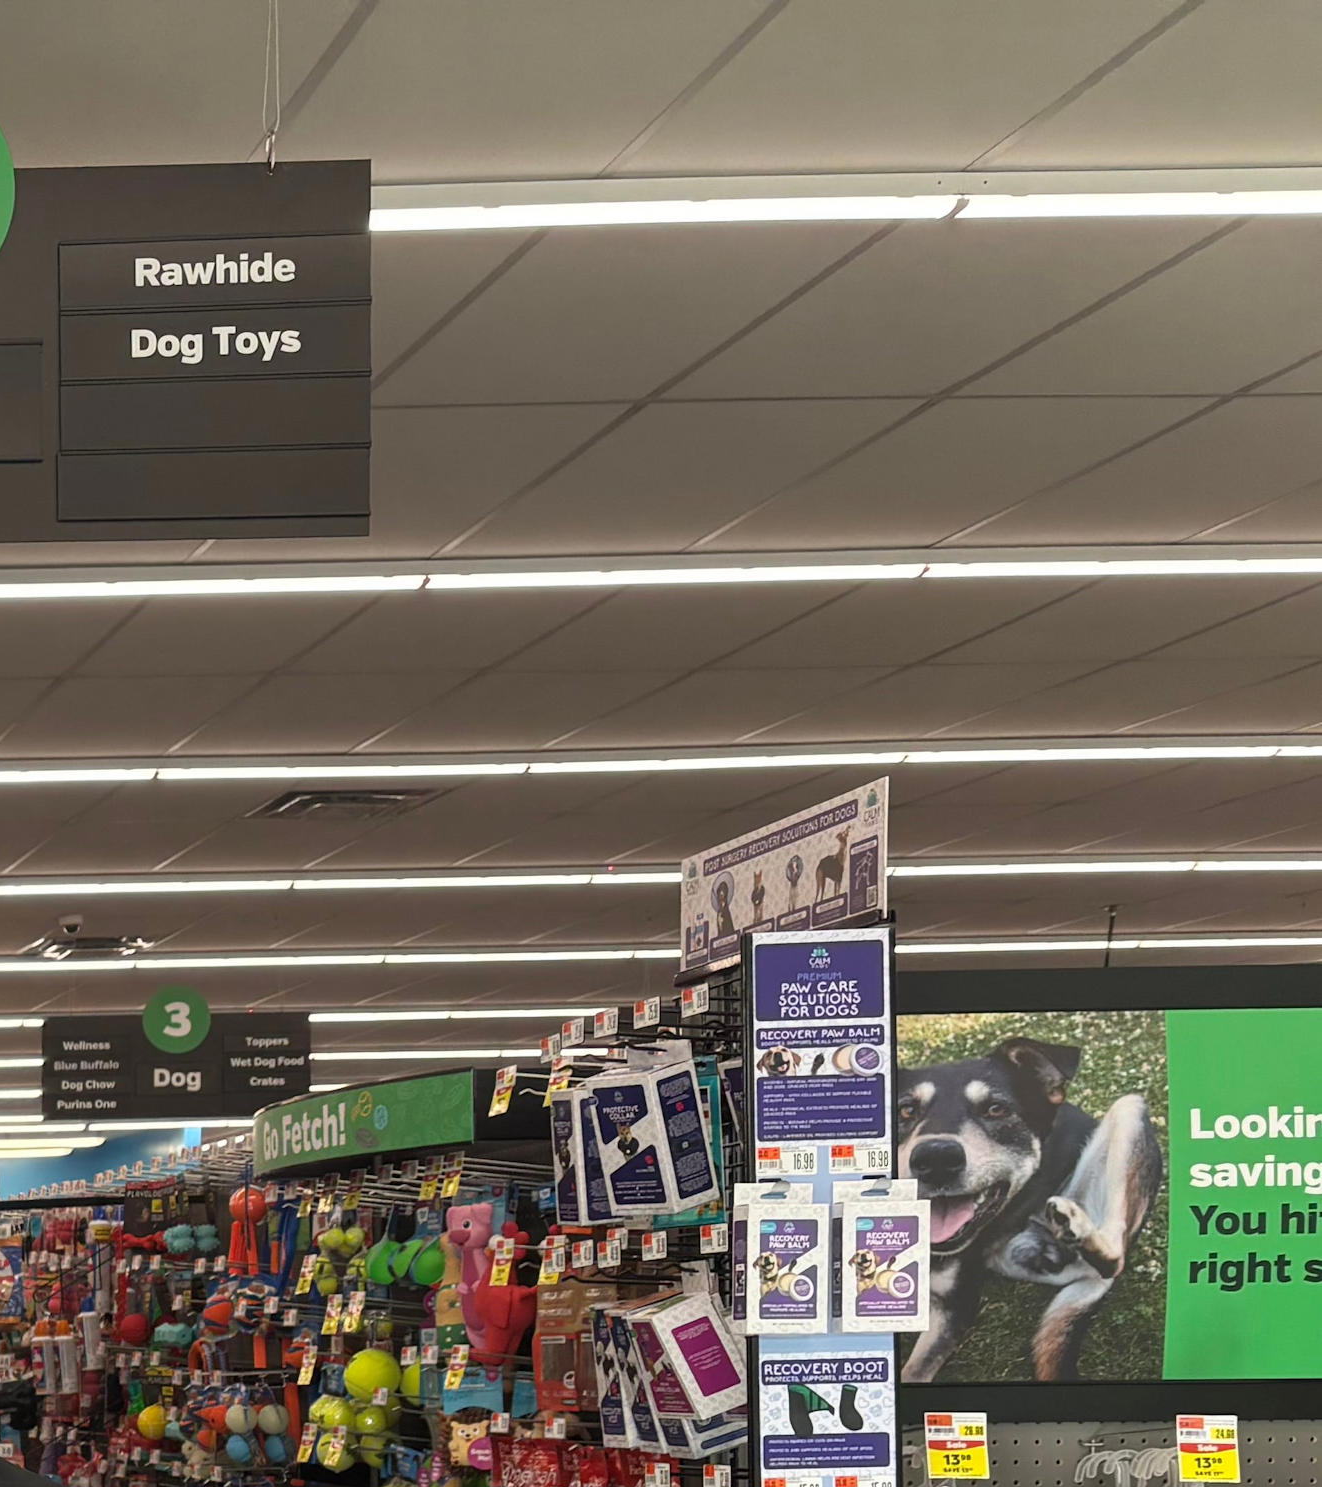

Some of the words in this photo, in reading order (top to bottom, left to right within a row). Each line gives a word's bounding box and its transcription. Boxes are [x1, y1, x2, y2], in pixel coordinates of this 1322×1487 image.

[134, 253, 296, 288] Rawhide
[130, 328, 203, 366] Dog
[211, 326, 302, 360] Toys
[781, 982, 811, 993] PAW
[817, 981, 857, 993] CARE
[779, 993, 861, 1006] SOLUTIONS
[781, 1006, 809, 1017] FOR
[814, 1004, 859, 1017] DOGS
[163, 1002, 192, 1037] 3
[760, 1030, 819, 1040] RECOVERY
[822, 1029, 845, 1038] PAW
[849, 1028, 880, 1037] BALM
[63, 1041, 110, 1051] Wellness
[245, 1037, 289, 1047] Toppers
[54, 1061, 77, 1070] Blue
[80, 1060, 119, 1070] Buffalo
[230, 1057, 251, 1067] Wet
[254, 1057, 275, 1068] Dog
[278, 1056, 304, 1066] Food
[61, 1080, 83, 1091] Dog
[85, 1080, 115, 1089] Chow
[154, 1069, 201, 1092] Dog
[250, 1077, 285, 1086] Crates
[57, 1100, 92, 1110] Purina
[95, 1100, 117, 1109] One
[264, 1120, 278, 1161] Go
[281, 1103, 346, 1155] Fetch!
[793, 1153, 814, 1170] 16.98
[1189, 1205, 1266, 1235] You
[1189, 1252, 1291, 1292] right
[765, 1362, 840, 1375] RECOVERY
[844, 1361, 884, 1373] BOOT
